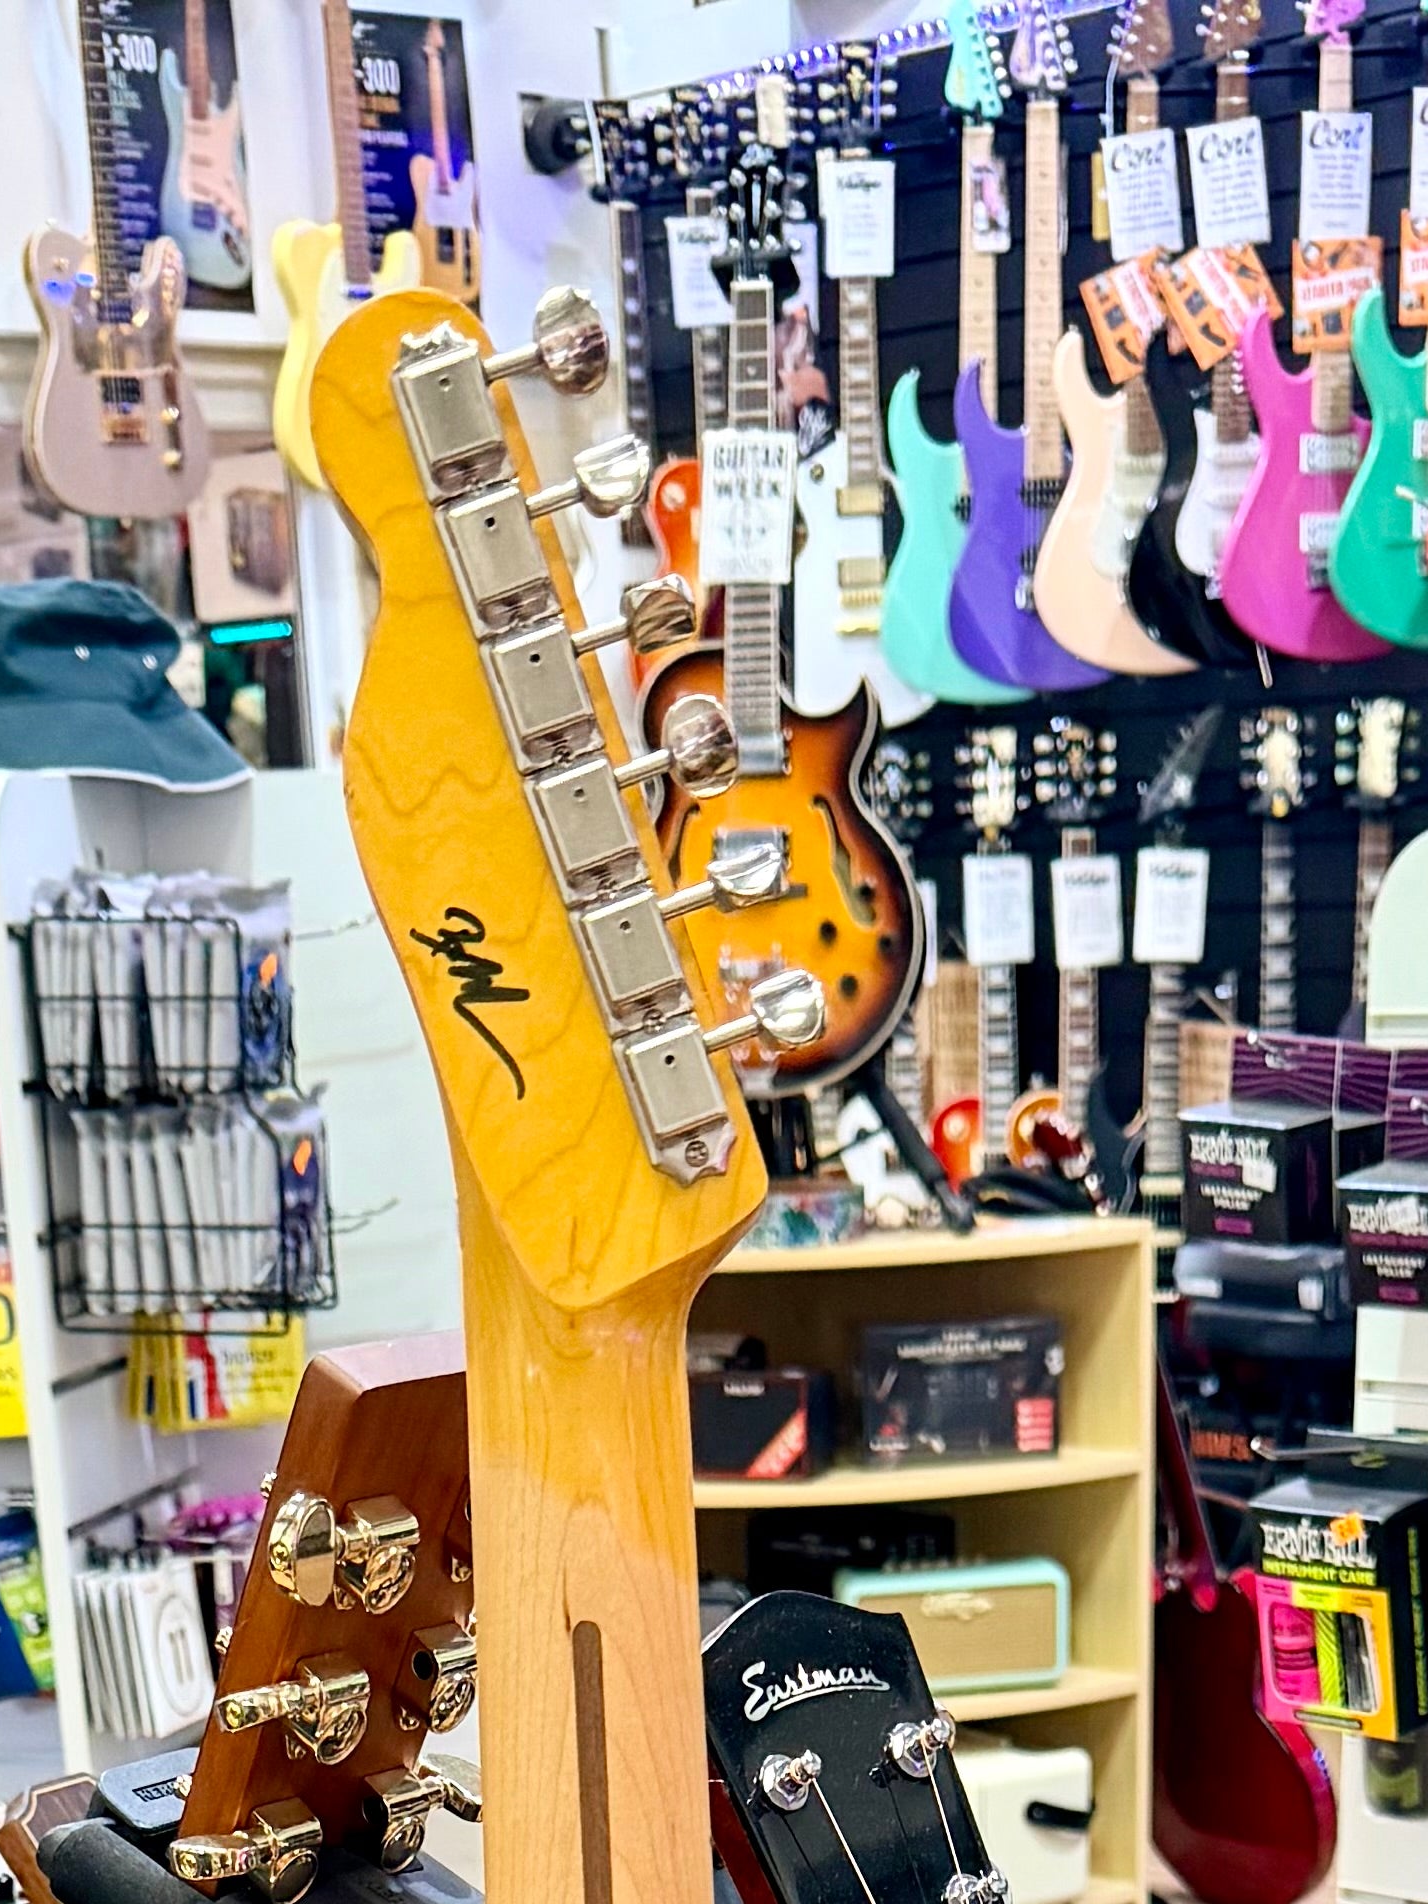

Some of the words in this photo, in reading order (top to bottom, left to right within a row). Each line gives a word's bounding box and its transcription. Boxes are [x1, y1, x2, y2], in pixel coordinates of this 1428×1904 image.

[1199, 127, 1256, 164] Cort
[1308, 118, 1365, 150] Cort
[1111, 139, 1167, 172] Cort
[1188, 1129, 1233, 1164] ERNIE
[1261, 1517, 1321, 1565] ERNIE
[1263, 1560, 1336, 1582] INSTRUMENT
[1337, 1566, 1376, 1586] CARE
[742, 1660, 891, 1722] Eastman
